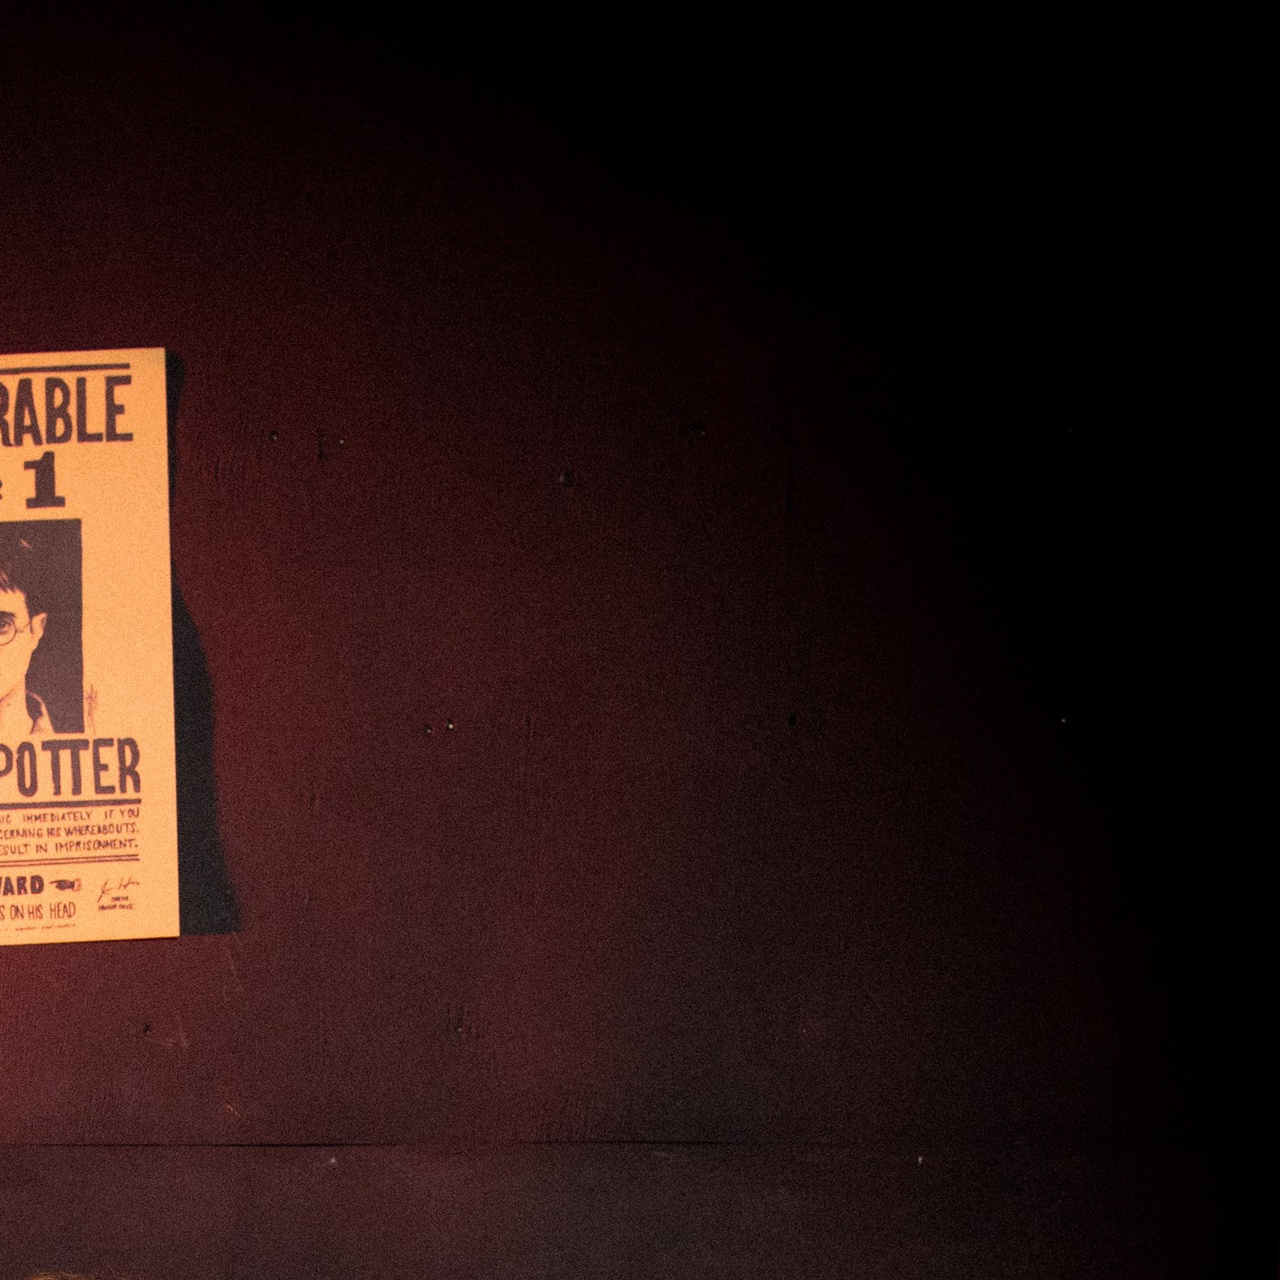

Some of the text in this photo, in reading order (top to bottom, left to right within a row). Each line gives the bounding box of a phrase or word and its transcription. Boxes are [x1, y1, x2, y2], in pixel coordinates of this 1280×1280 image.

[22, 449, 66, 508] 1
[23, 810, 93, 823] IMMEDIATELY
[104, 809, 114, 819] IF
[119, 806, 140, 818] YOU
[46, 826, 61, 837] HIS
[35, 843, 48, 853] IN
[54, 837, 138, 853] IMPRISONMENT.
[9, 903, 25, 922] ON
[27, 902, 43, 920] HIS
[49, 900, 77, 919] HEAD
